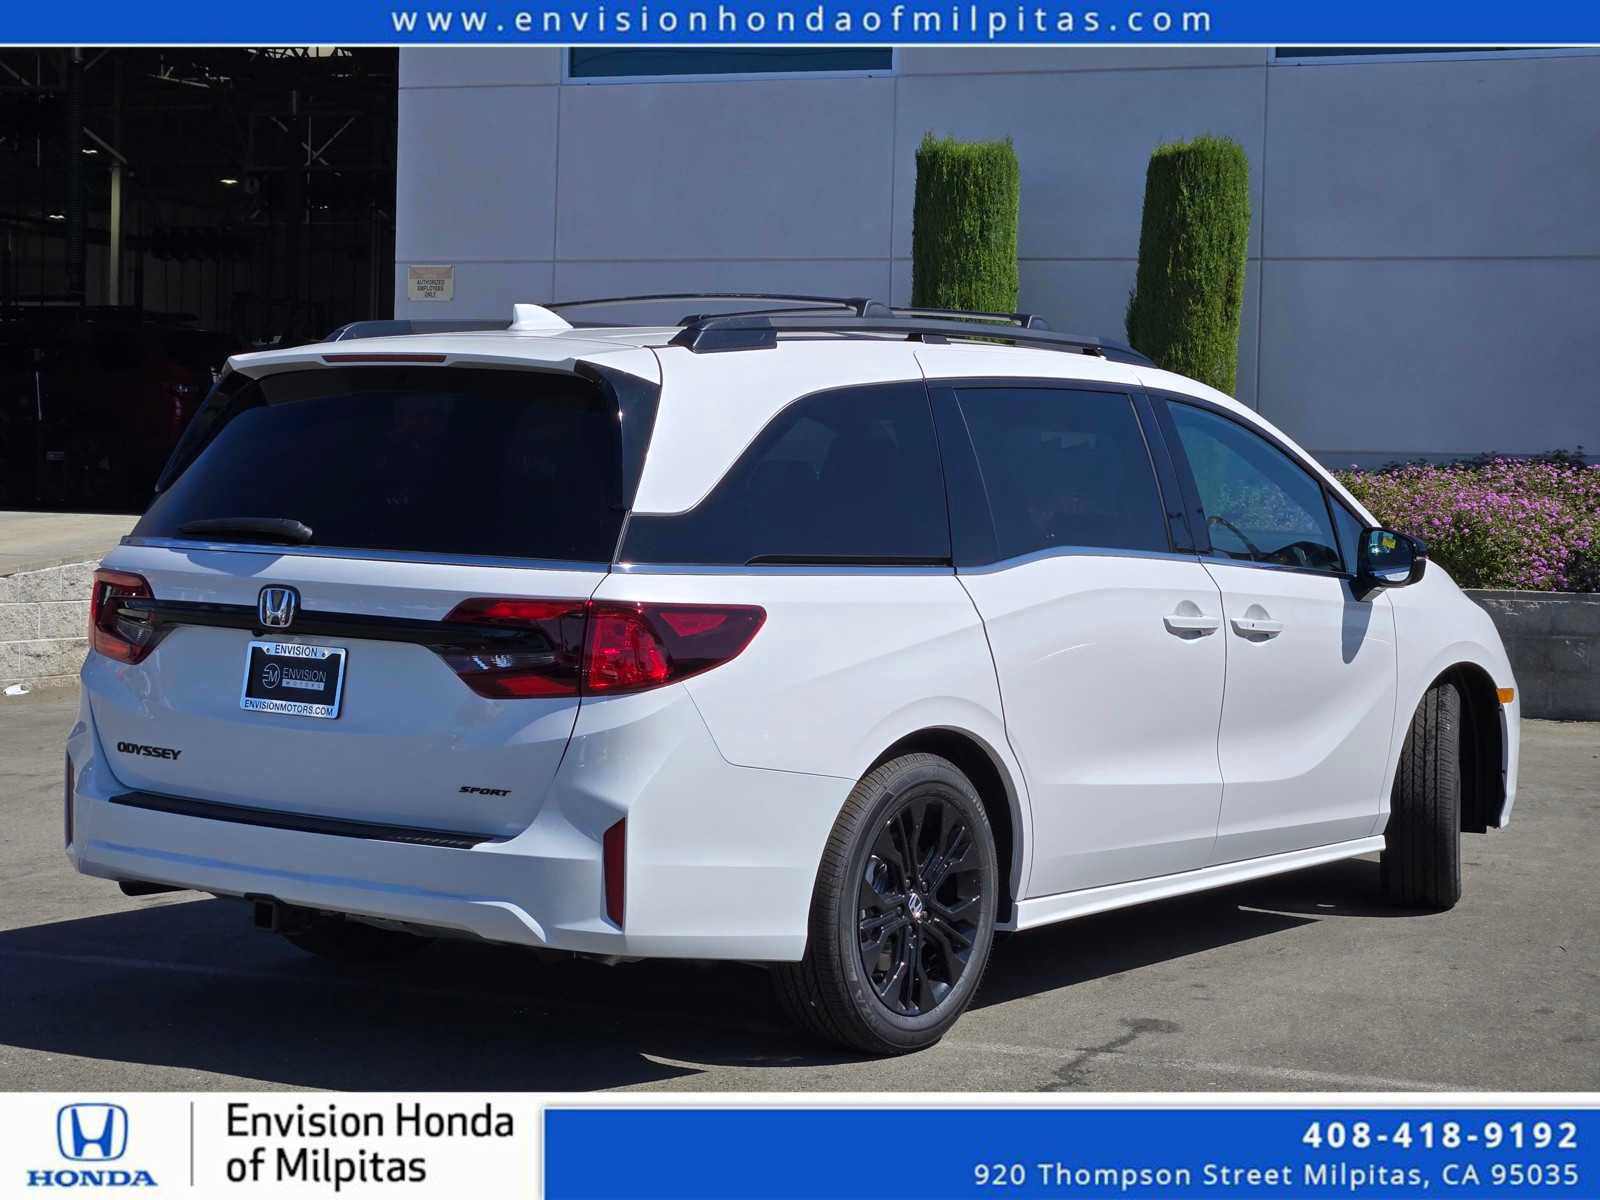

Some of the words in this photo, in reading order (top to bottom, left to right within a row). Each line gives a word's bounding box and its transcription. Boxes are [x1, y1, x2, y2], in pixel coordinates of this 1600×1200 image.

[274, 644, 318, 657] ENVISION
[282, 667, 327, 682] ENVISION
[244, 701, 334, 716] ENVISIONMOTORS.COM
[117, 741, 182, 760] ODYSSEY
[459, 786, 512, 797] SPORT
